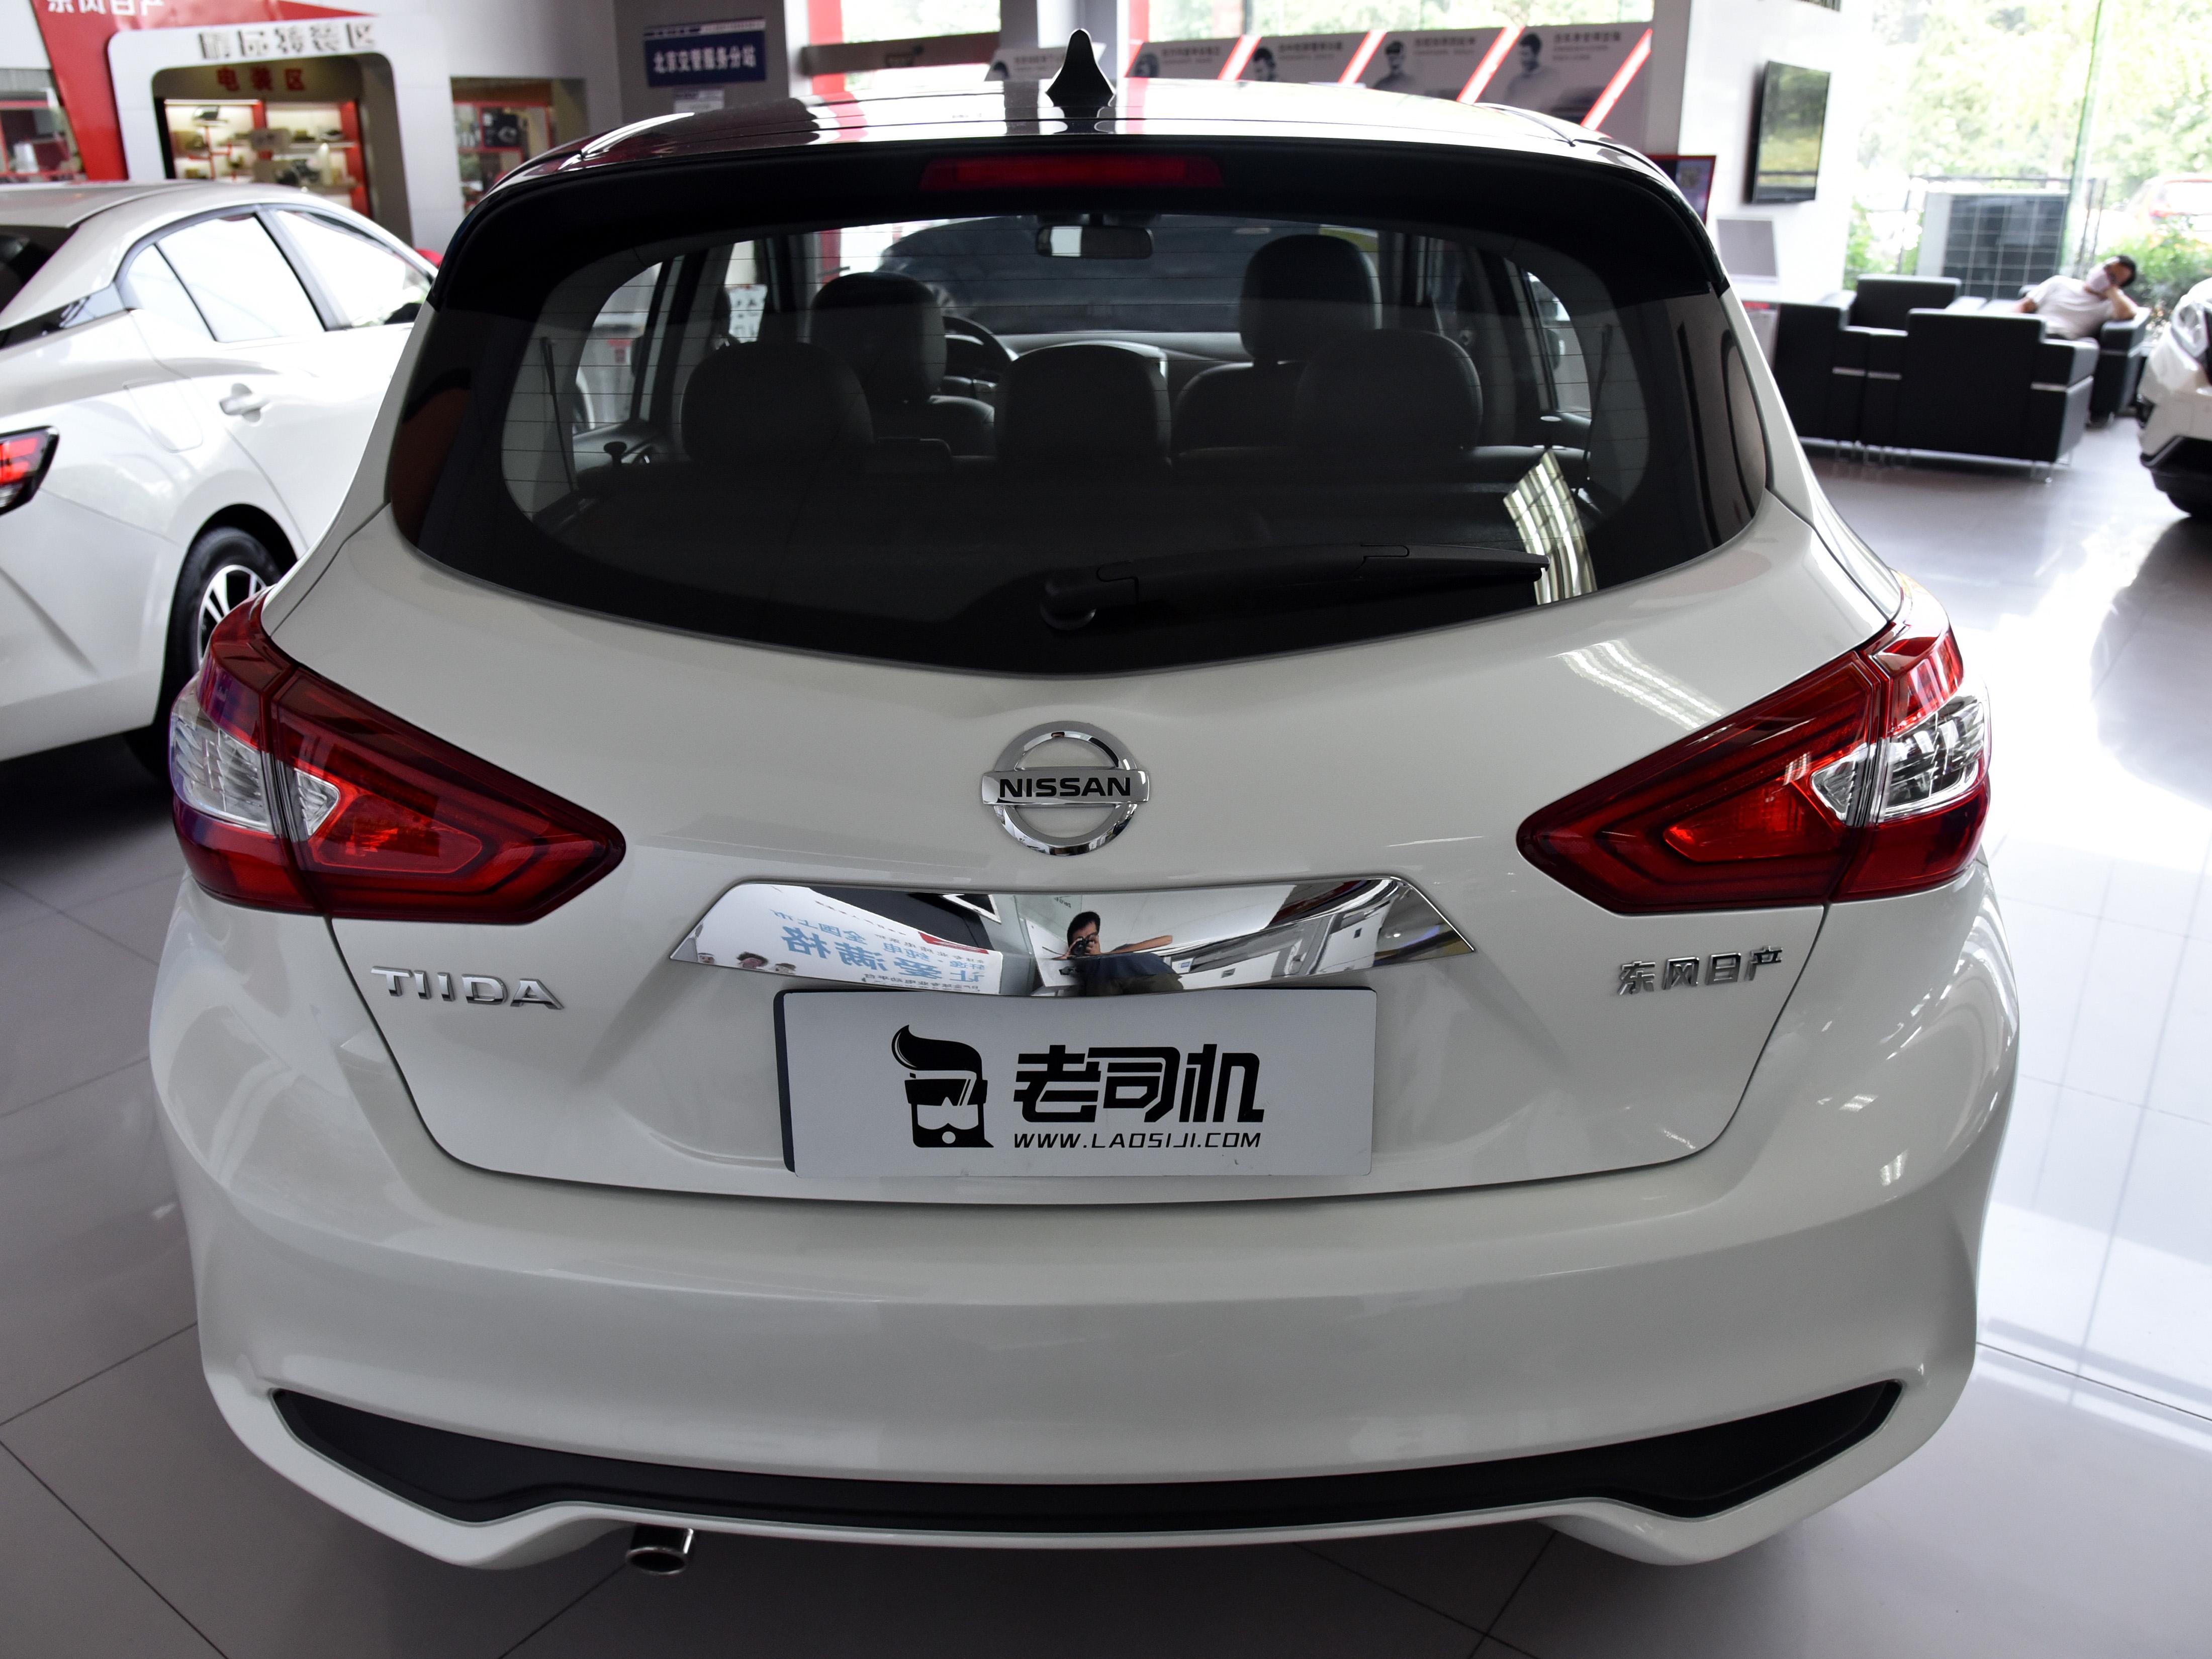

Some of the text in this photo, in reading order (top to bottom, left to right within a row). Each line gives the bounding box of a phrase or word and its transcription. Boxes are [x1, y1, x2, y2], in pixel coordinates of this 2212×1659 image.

[999, 777, 1131, 798] NISSAN
[371, 966, 564, 1009] TIIDA
[1617, 946, 1783, 995] 东风日产
[1013, 1044, 1265, 1123] 老司机
[1013, 1133, 1261, 1149] WWW.LAOSIJI.COM
